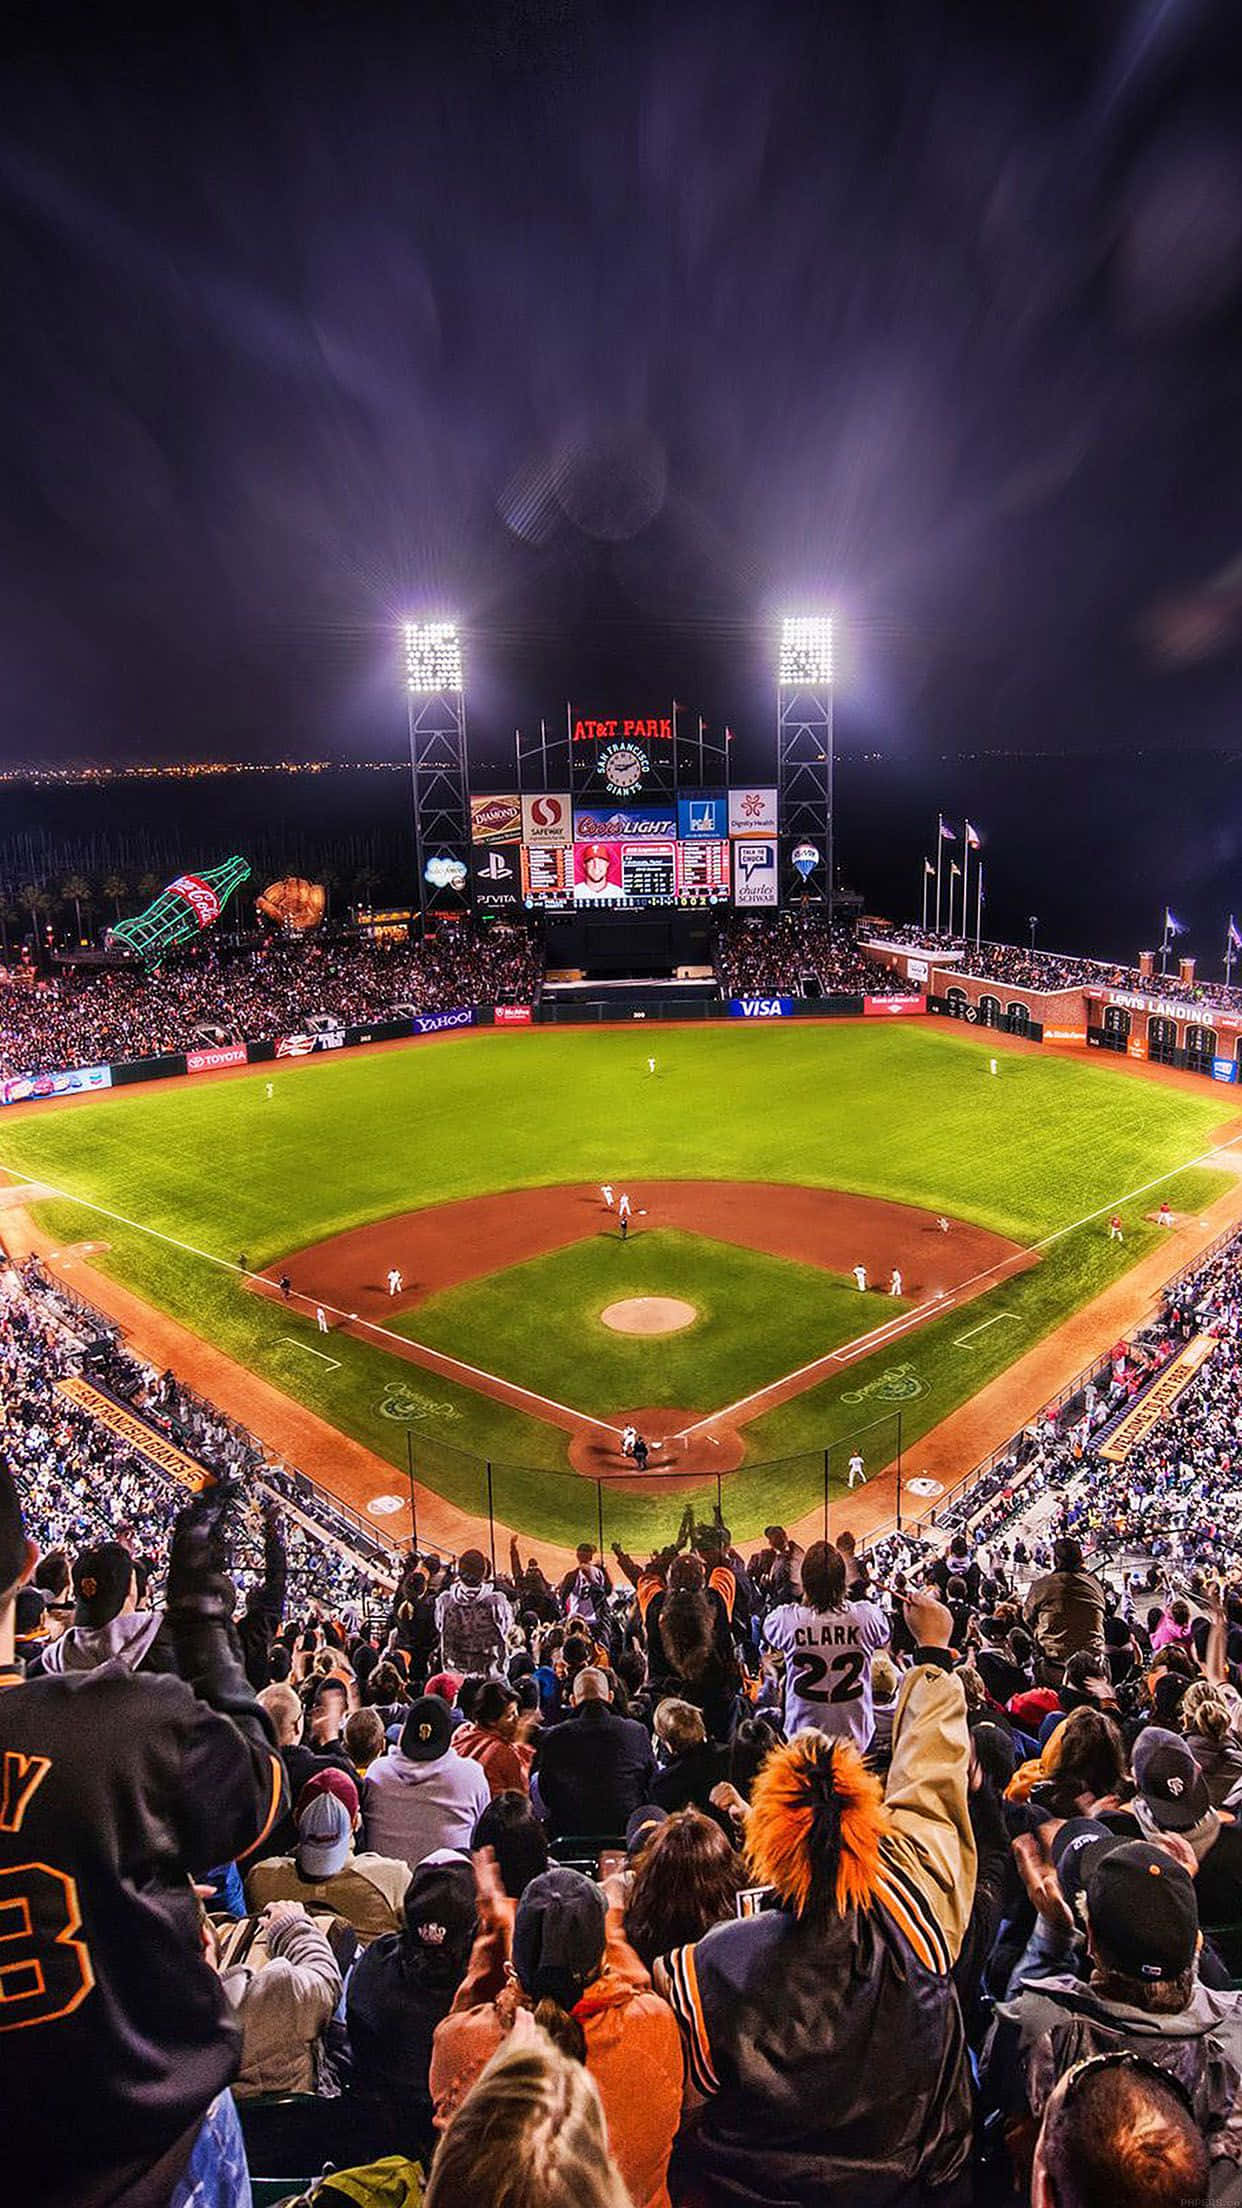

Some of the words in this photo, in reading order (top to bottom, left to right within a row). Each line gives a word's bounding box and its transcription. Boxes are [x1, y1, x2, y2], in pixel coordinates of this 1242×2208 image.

[572, 720, 618, 741] AT&T
[623, 719, 673, 739] PARK
[597, 752, 609, 774] SAN
[606, 742, 650, 773] FRANCISCO
[606, 782, 642, 796] GIANTS
[475, 807, 518, 825] DIAMOND
[530, 828, 564, 836] SAFEWAY
[622, 820, 673, 835] LIGHT
[739, 1001, 782, 1016] VISA
[1148, 1001, 1214, 1026] LANDING
[416, 1010, 473, 1033] YAHOO!
[205, 1050, 247, 1065] TOYOTA
[75, 1390, 99, 1411] SAN
[97, 1402, 150, 1447] FRANCISCO
[143, 1440, 191, 1474] GIANTS
[1107, 1412, 1153, 1452] WELCOME
[794, 1625, 860, 1646] CLARK
[792, 1651, 865, 1702] 22
